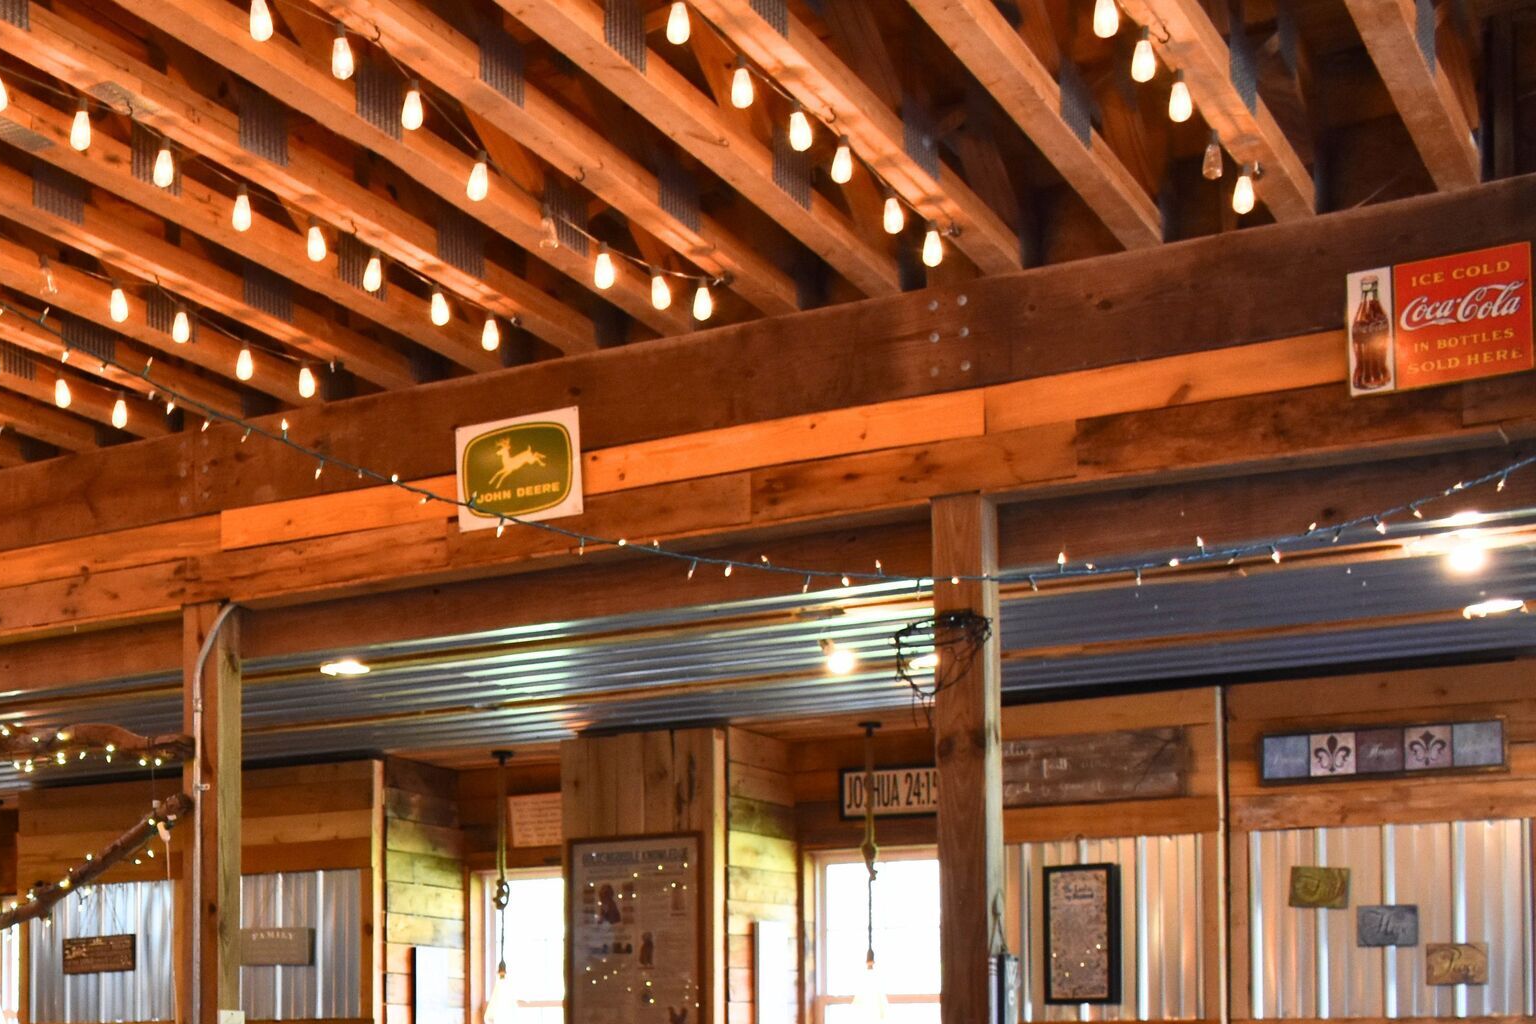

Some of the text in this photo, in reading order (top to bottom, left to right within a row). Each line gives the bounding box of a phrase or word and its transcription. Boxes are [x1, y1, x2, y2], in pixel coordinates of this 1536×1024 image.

[1411, 260, 1511, 287] ICE COLD
[1399, 280, 1525, 332] Coca-Cola
[1414, 328, 1515, 354] IN BOTTLES
[1407, 348, 1524, 375] SOLD HERE
[477, 481, 561, 504] JOHN DEERE
[846, 773, 901, 810] JOHUA
[251, 930, 295, 941] FAMILY
